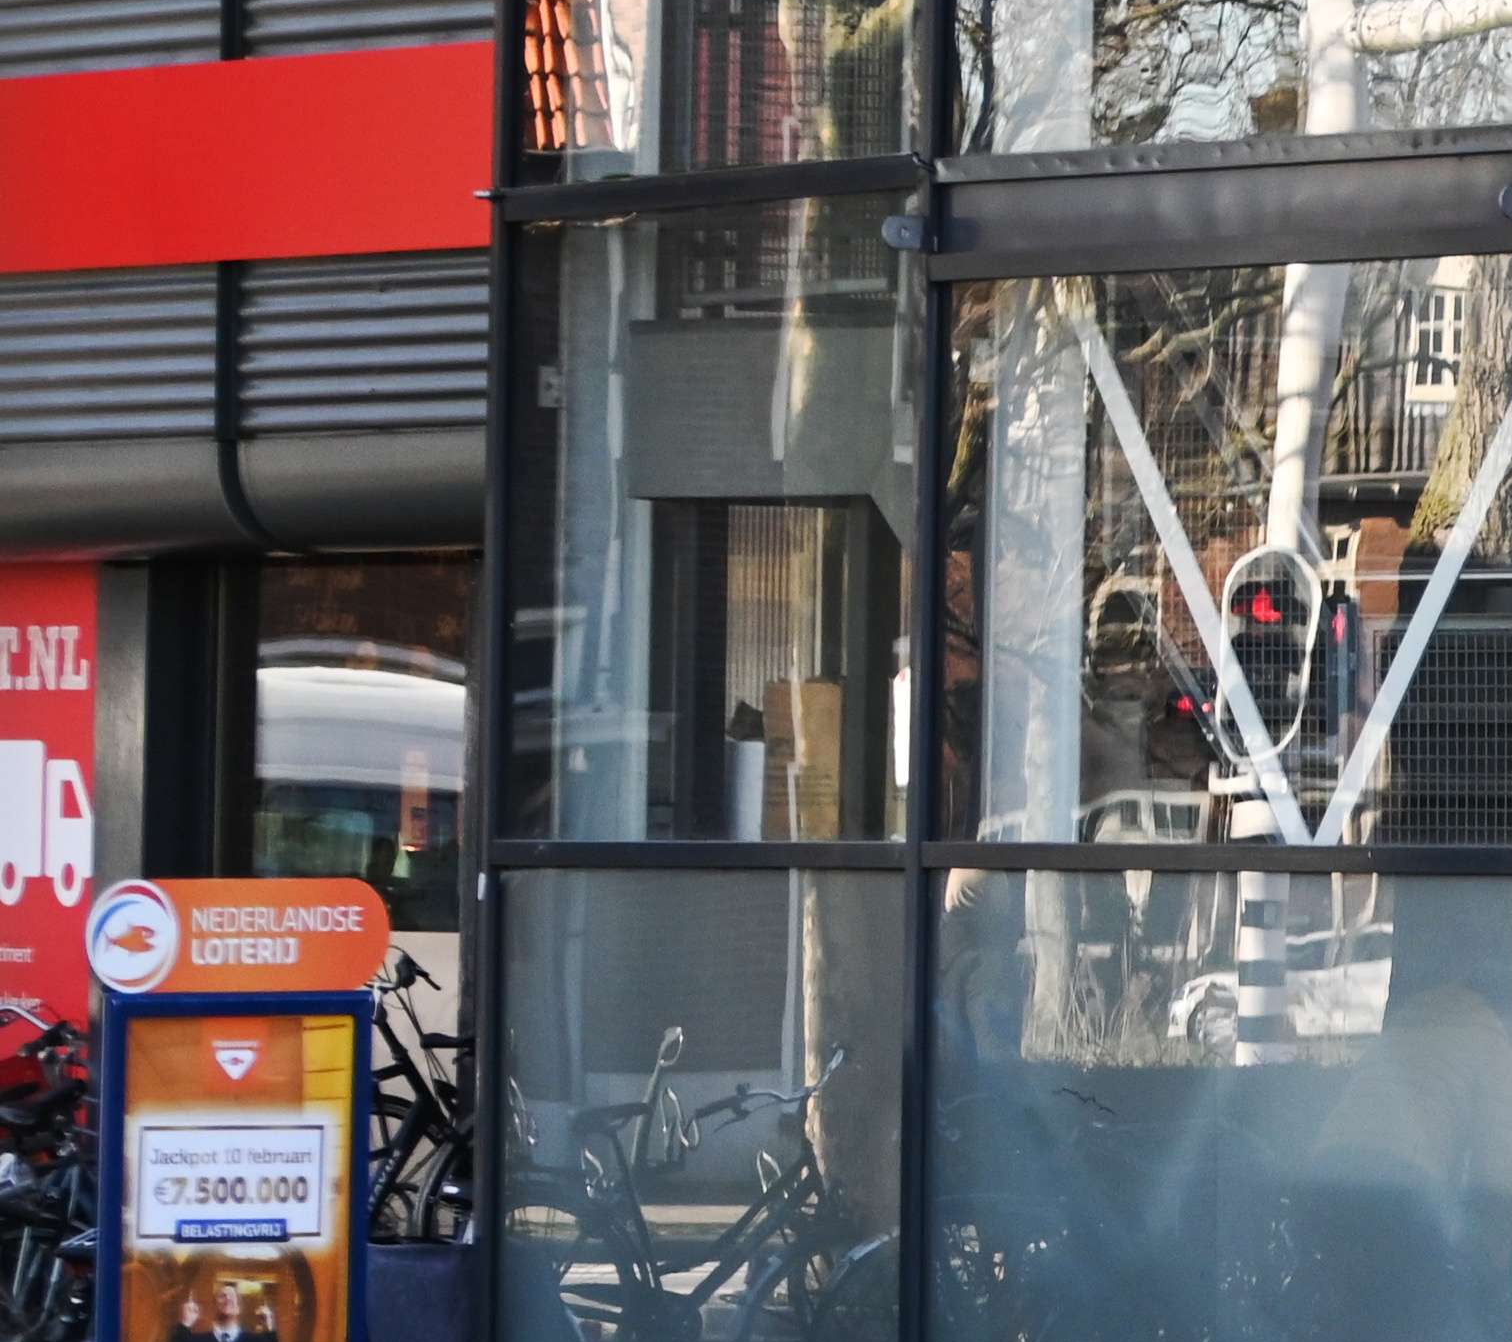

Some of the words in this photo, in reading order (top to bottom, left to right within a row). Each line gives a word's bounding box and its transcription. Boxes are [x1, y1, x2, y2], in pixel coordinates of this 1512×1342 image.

[191, 905, 364, 934] NEDERLANDSE
[191, 937, 300, 966] LOTERIJ
[152, 1147, 218, 1168] Jackpot
[224, 1148, 242, 1165] 10
[248, 1147, 313, 1165] februari
[154, 1176, 309, 1206] €7.500.000
[180, 1223, 283, 1240] BELASTINGVRIJ
